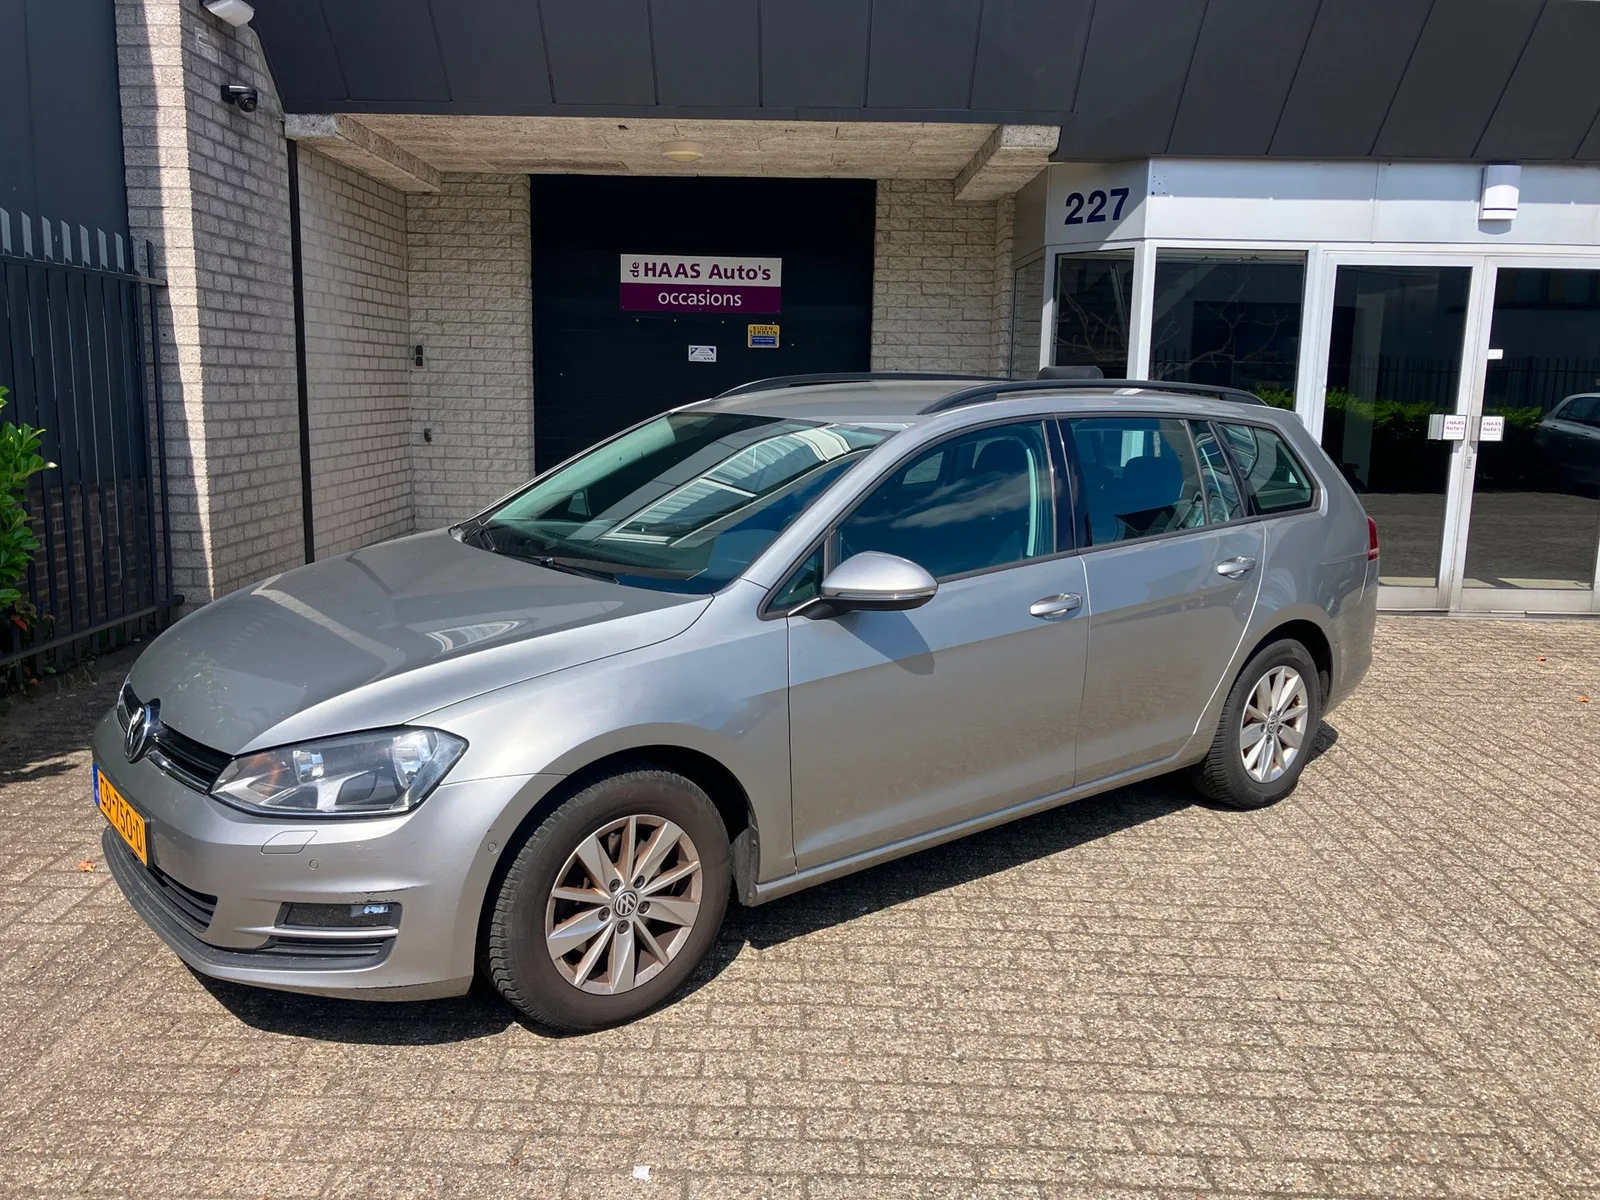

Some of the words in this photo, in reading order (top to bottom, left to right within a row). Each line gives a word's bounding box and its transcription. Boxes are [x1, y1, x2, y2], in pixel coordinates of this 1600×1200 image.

[1064, 187, 1130, 225] 227
[629, 262, 640, 278] de
[643, 262, 701, 279] HAAS
[708, 264, 771, 281] Auto's
[658, 289, 742, 307] occasions
